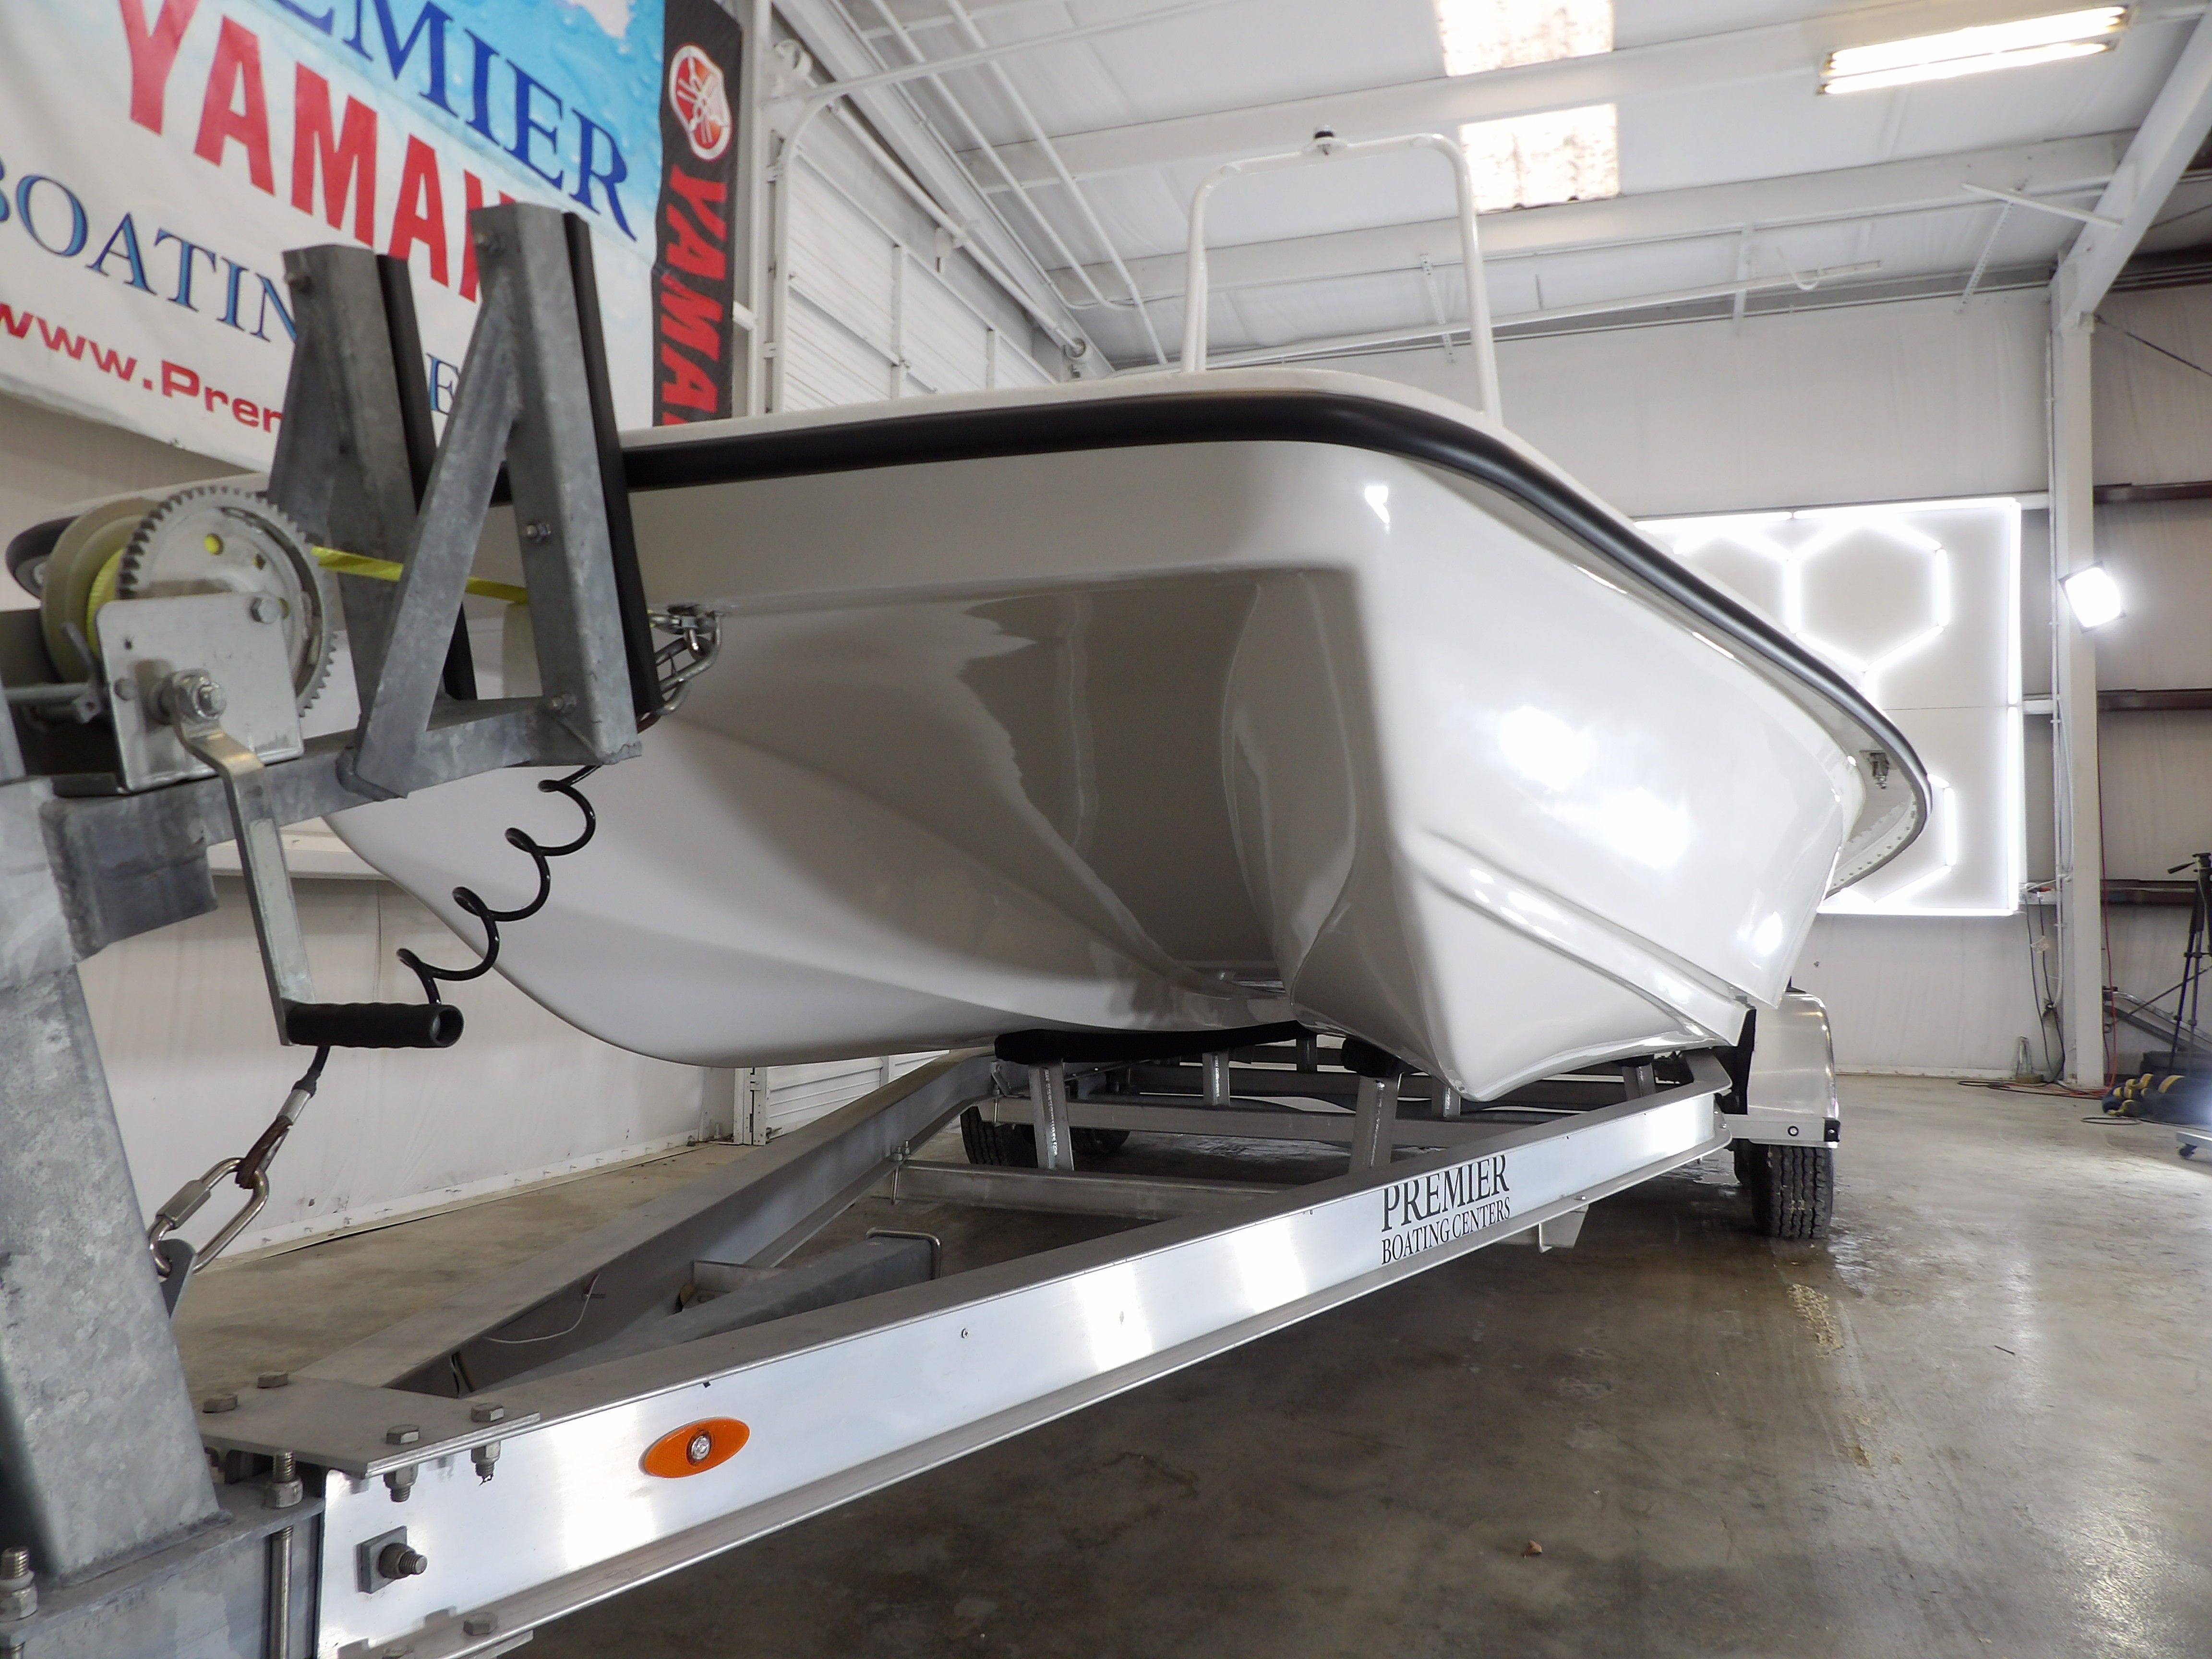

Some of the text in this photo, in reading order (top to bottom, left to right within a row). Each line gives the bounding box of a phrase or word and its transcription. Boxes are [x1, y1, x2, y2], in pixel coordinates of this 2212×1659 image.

[661, 164, 727, 425] YAMA
[1381, 1154, 1510, 1232] PREMIER
[1381, 1196, 1511, 1265] BOATING CENTERS
